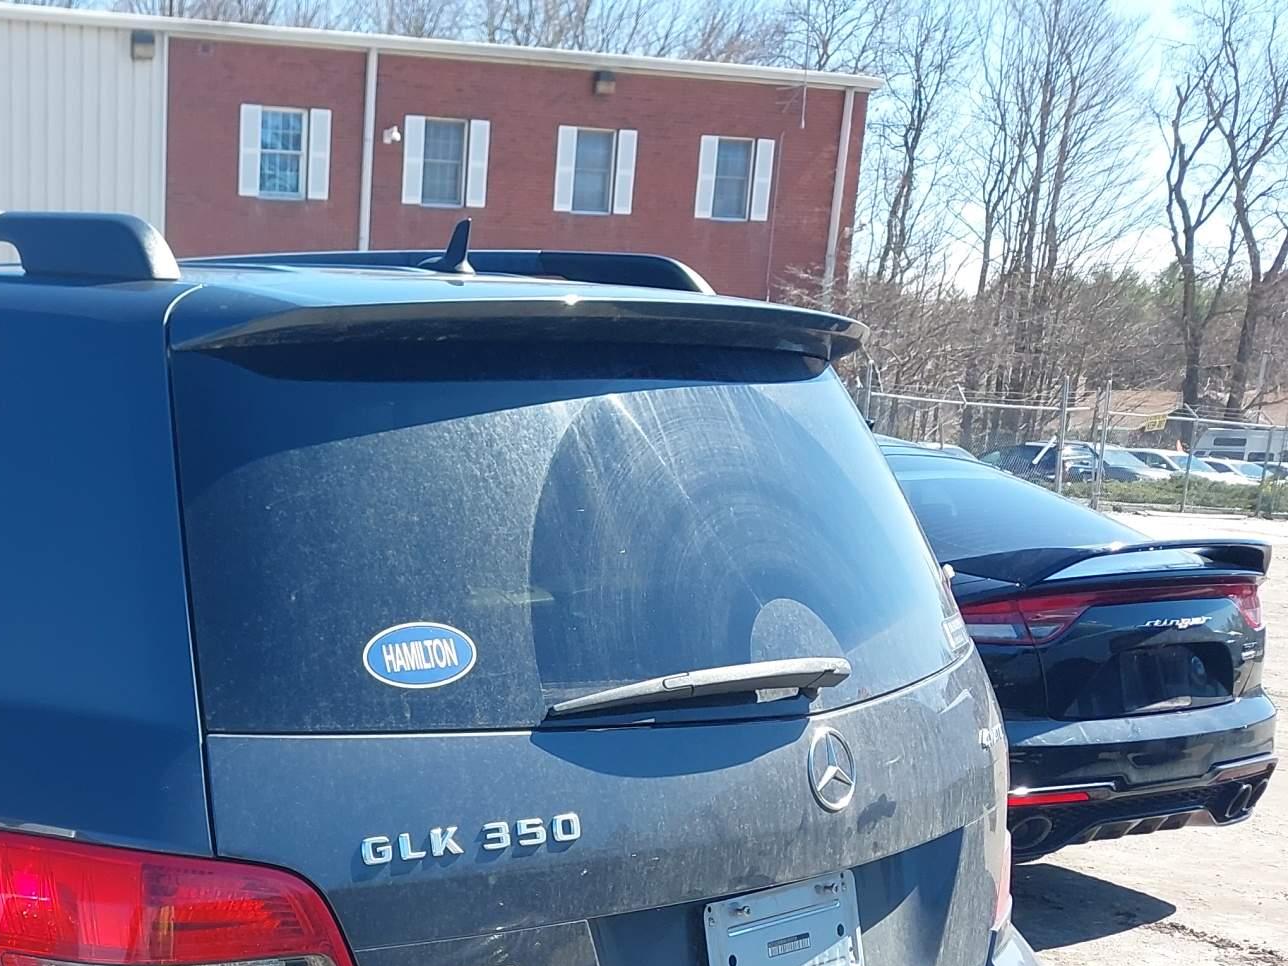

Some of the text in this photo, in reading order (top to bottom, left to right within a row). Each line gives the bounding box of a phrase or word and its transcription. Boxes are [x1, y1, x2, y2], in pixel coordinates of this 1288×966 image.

[381, 638, 459, 673] HAMILTON
[361, 811, 582, 866] GLK 350
